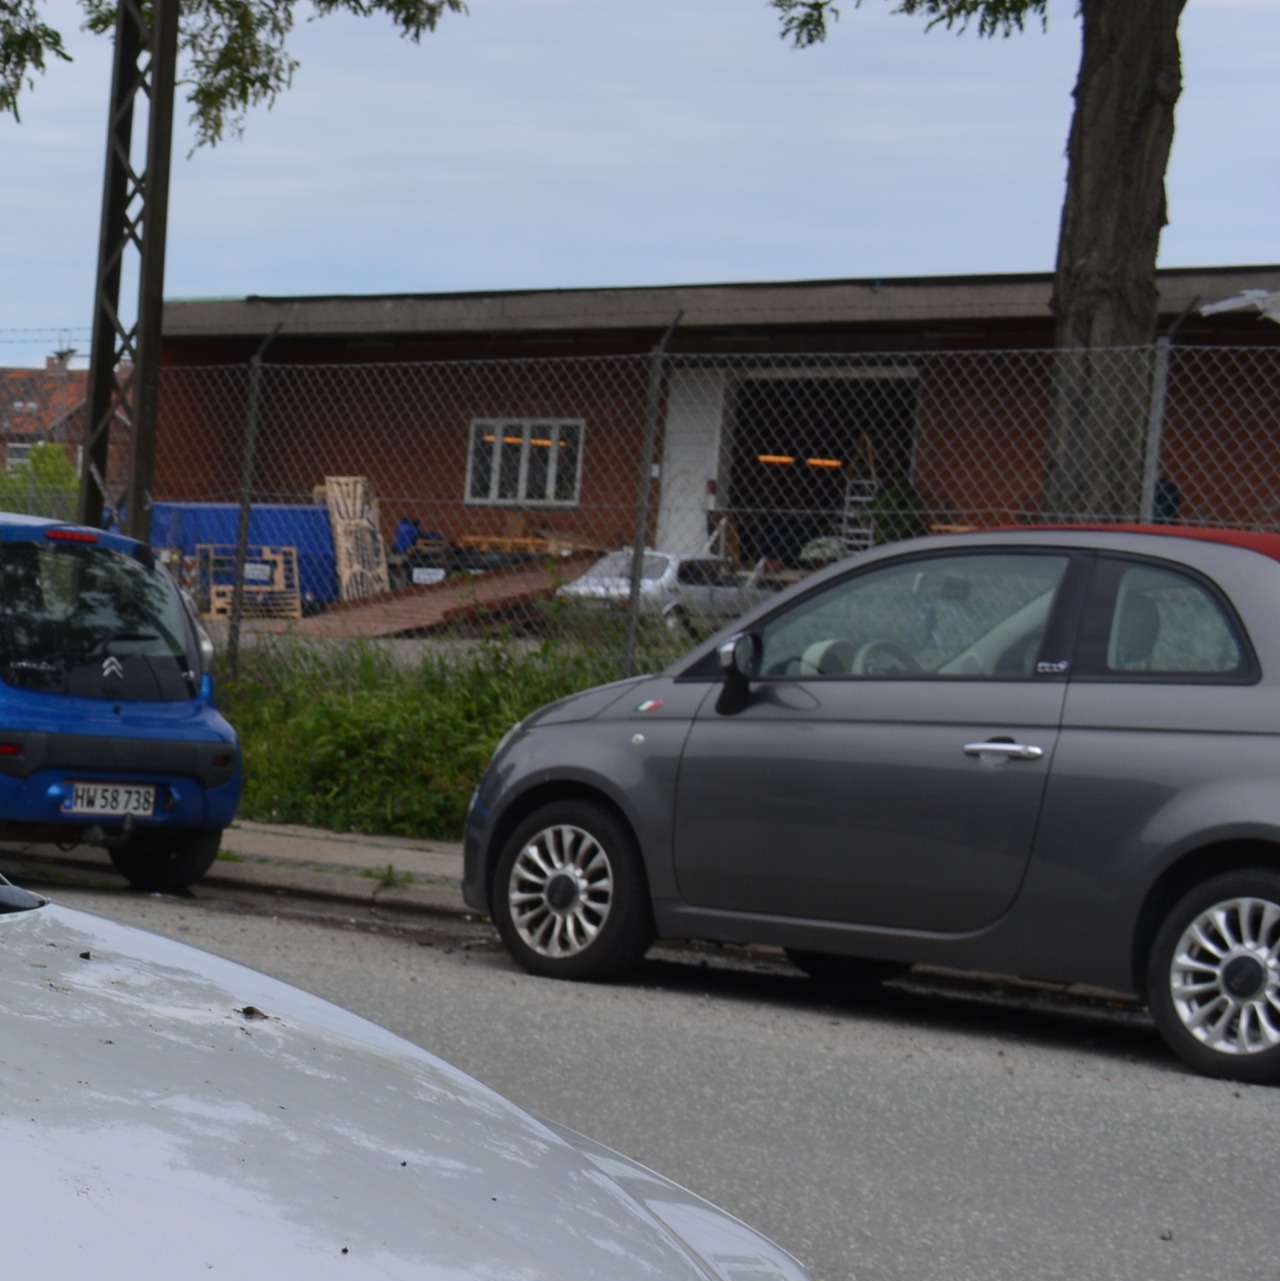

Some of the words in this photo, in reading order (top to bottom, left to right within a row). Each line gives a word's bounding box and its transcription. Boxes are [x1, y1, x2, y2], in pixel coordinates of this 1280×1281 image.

[73, 787, 97, 808] HW
[100, 788, 120, 810] 58
[123, 789, 153, 812] 738
